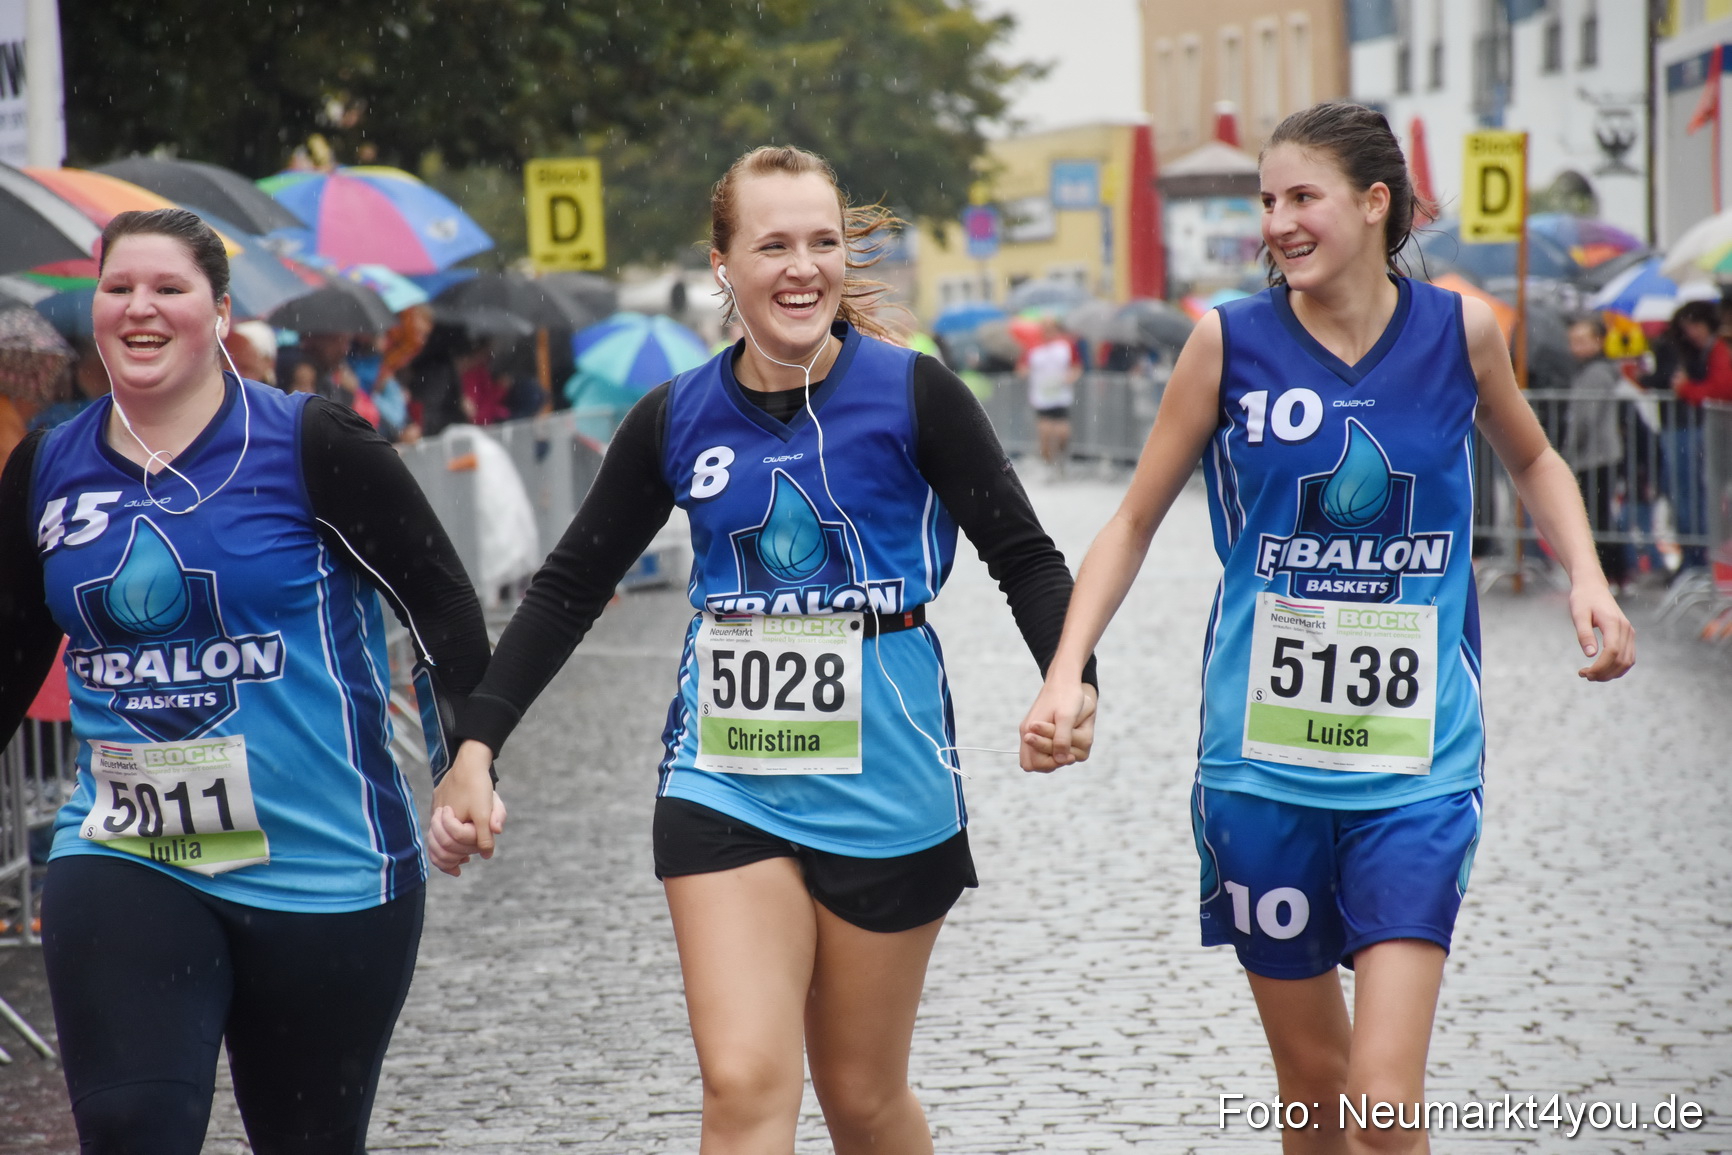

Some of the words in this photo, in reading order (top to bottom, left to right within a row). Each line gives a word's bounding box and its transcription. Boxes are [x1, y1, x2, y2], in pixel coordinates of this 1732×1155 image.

[1480, 166, 1511, 215] D
[548, 195, 584, 245] D
[1238, 387, 1324, 443] 10
[690, 445, 735, 499] 8
[37, 490, 123, 553] 45
[1305, 579, 1389, 595] BASKETS
[710, 627, 754, 637] NeuerMarkt
[763, 616, 846, 637] BOCK
[1271, 613, 1327, 630] NeuerMarkt
[1337, 608, 1420, 632] BOCK
[75, 640, 279, 686] FIBALON
[1270, 636, 1420, 709] 5138
[712, 650, 846, 713] 5028
[124, 691, 217, 710] BASKETS
[1255, 689, 1263, 702] S
[703, 703, 710, 716] S
[727, 726, 821, 752] Christina
[1306, 719, 1369, 748] Luisa
[144, 743, 230, 767] BOCK
[103, 777, 235, 838] 5011
[87, 826, 94, 837] S
[1224, 880, 1310, 940] 10
